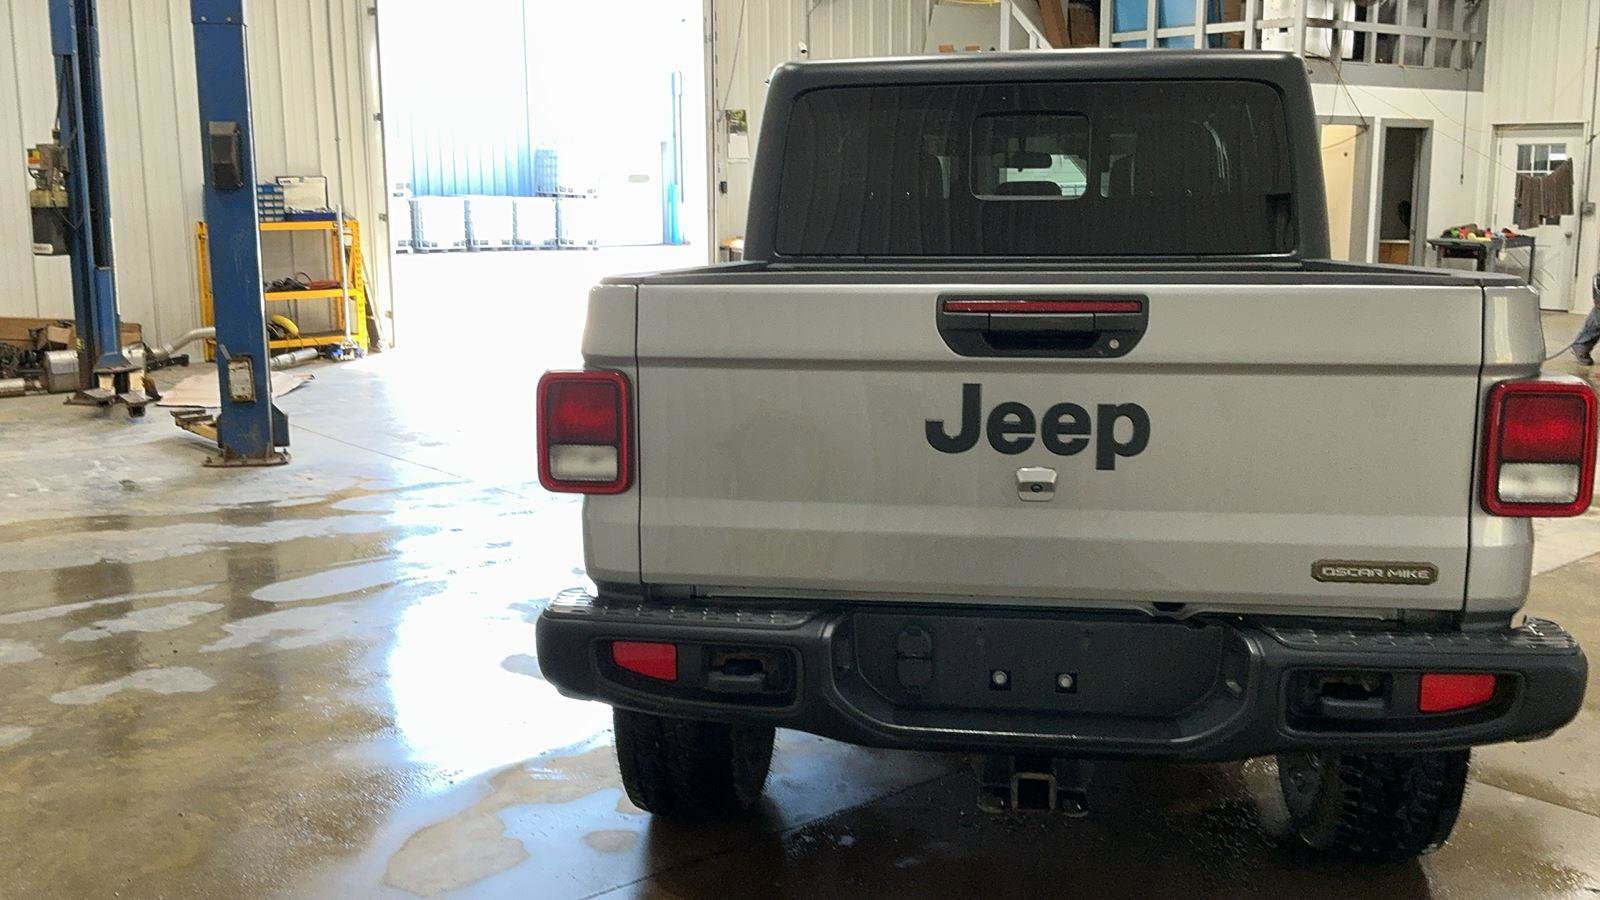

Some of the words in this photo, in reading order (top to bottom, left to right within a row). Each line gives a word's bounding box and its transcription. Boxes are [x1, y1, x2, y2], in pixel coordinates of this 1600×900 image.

[925, 383, 1151, 470] Jeep
[1321, 566, 1385, 578] OSCAR
[1387, 568, 1431, 580] MIKE
